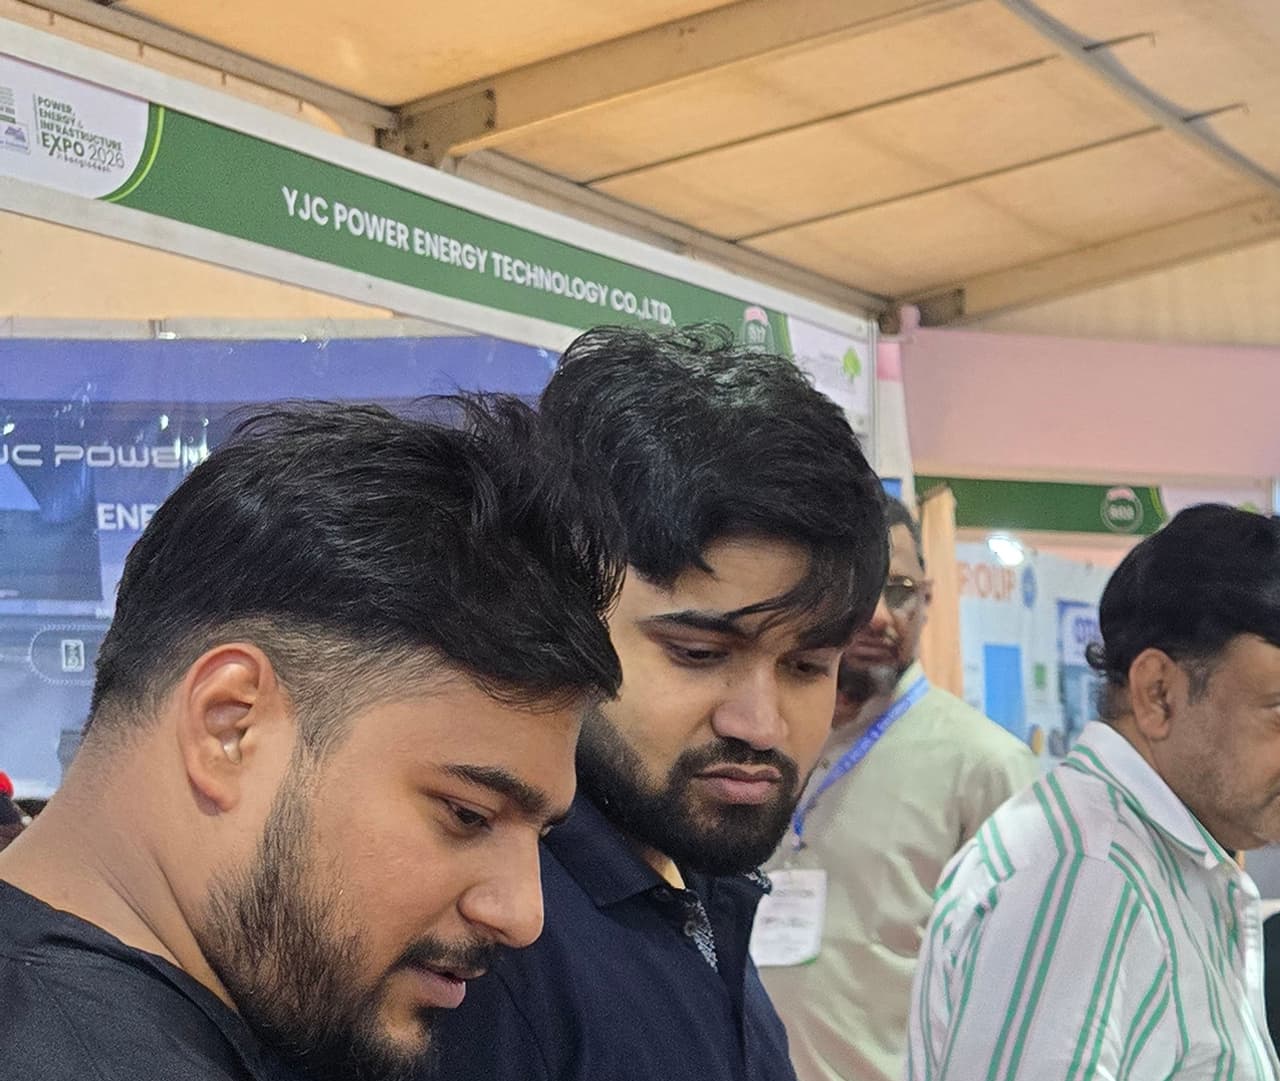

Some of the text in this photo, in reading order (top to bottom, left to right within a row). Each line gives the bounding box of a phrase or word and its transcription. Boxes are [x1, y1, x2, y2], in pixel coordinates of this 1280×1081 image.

[41, 131, 85, 157] EXPO
[281, 185, 328, 225] YJC
[333, 202, 409, 251] POWER
[413, 227, 488, 273] ENERGY
[491, 251, 608, 306] TECHNOLOGY
